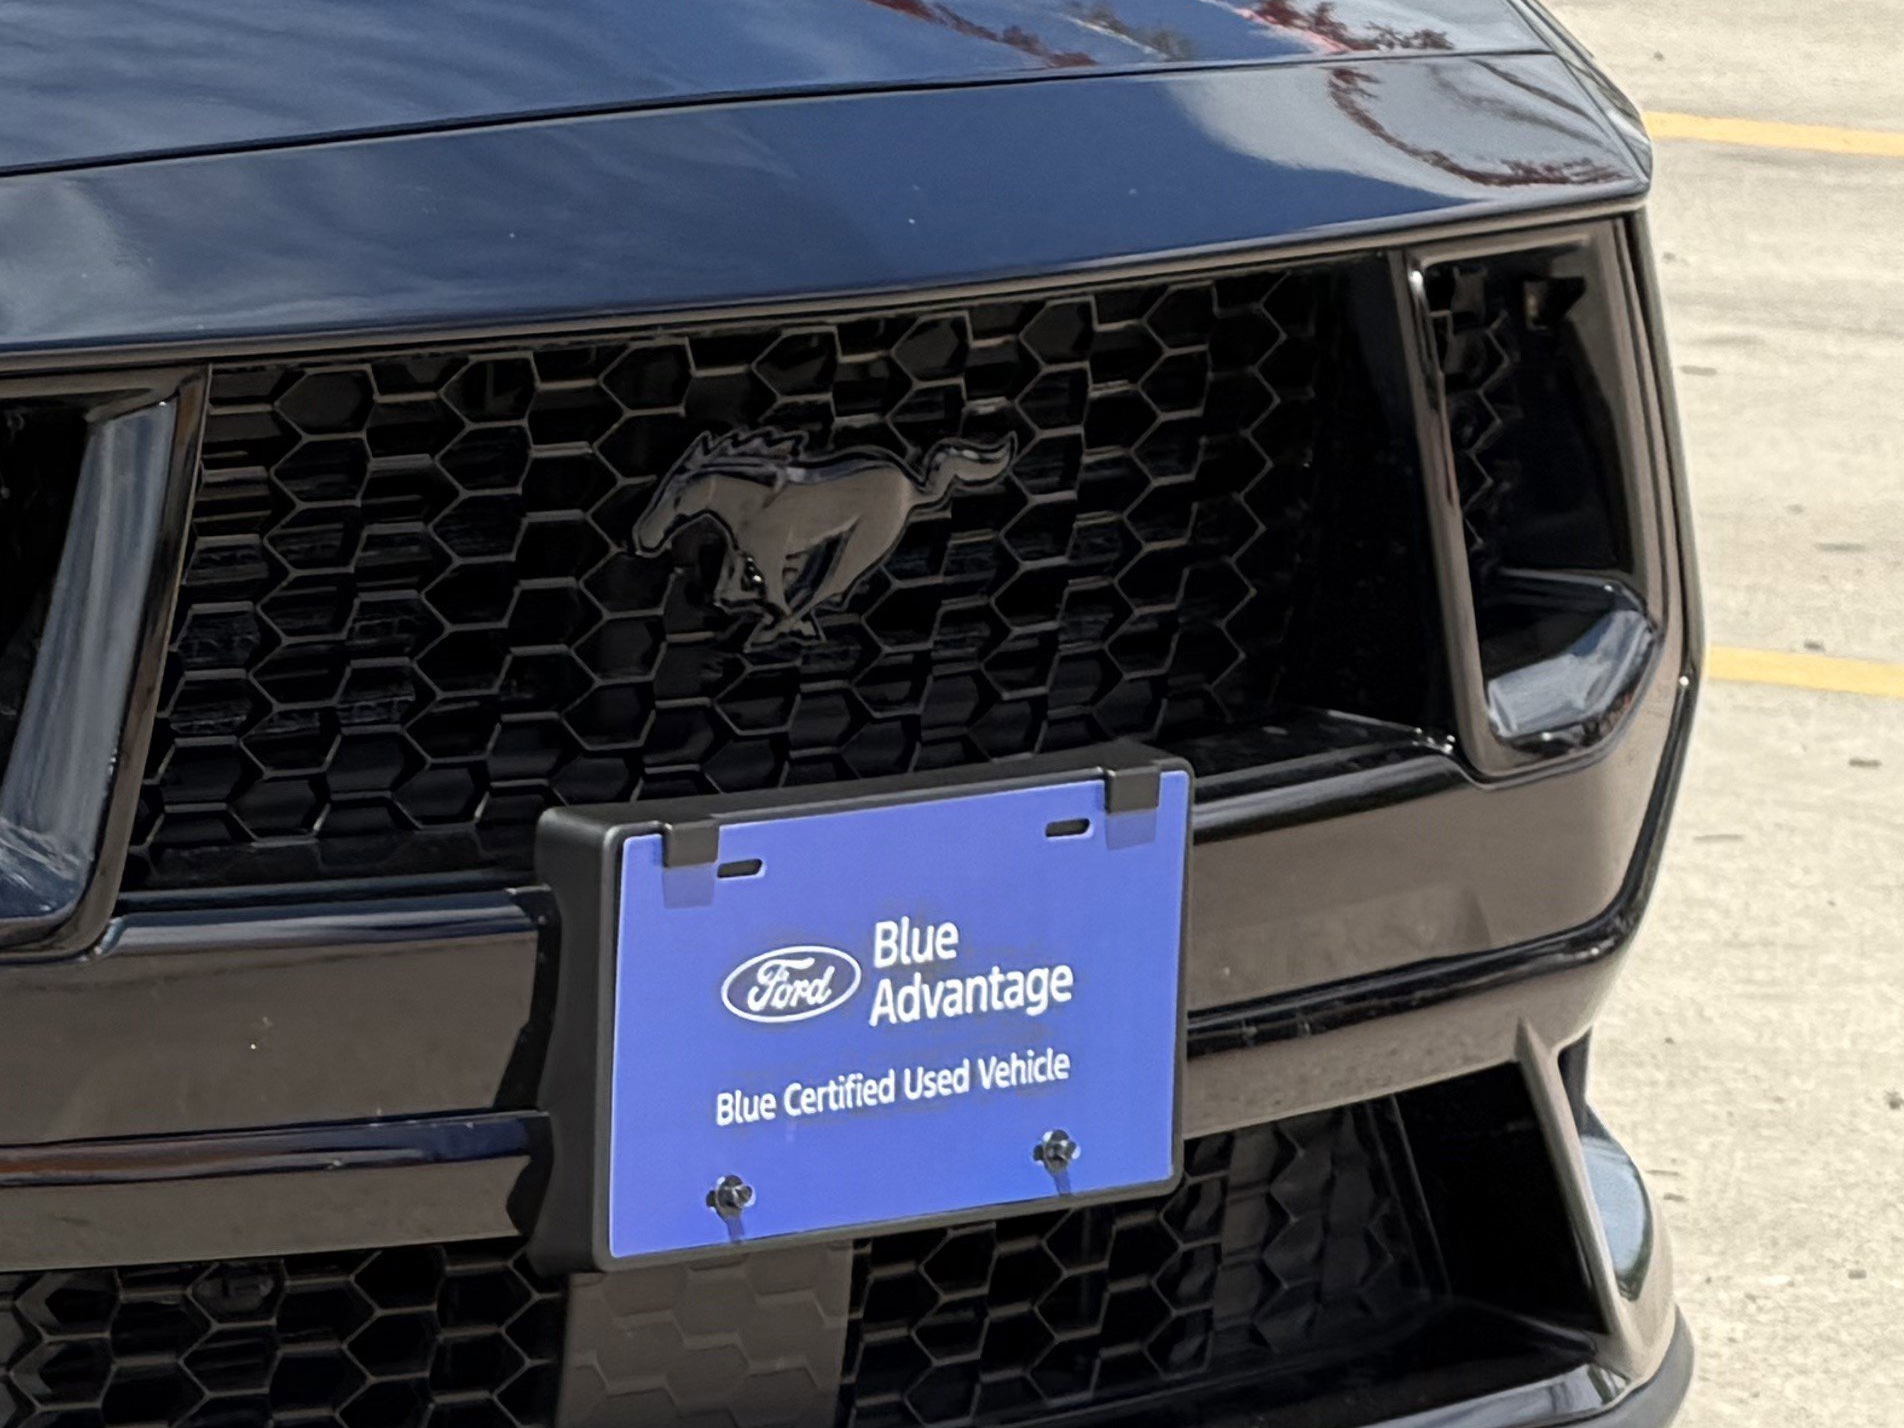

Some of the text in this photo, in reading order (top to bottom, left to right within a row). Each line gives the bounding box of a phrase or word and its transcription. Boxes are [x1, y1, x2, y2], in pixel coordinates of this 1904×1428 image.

[874, 916, 959, 968] Blue
[747, 957, 835, 1011] Ford
[869, 965, 1074, 1026] Advantage
[716, 1047, 1071, 1126] Blue Certified Used Vehicle
